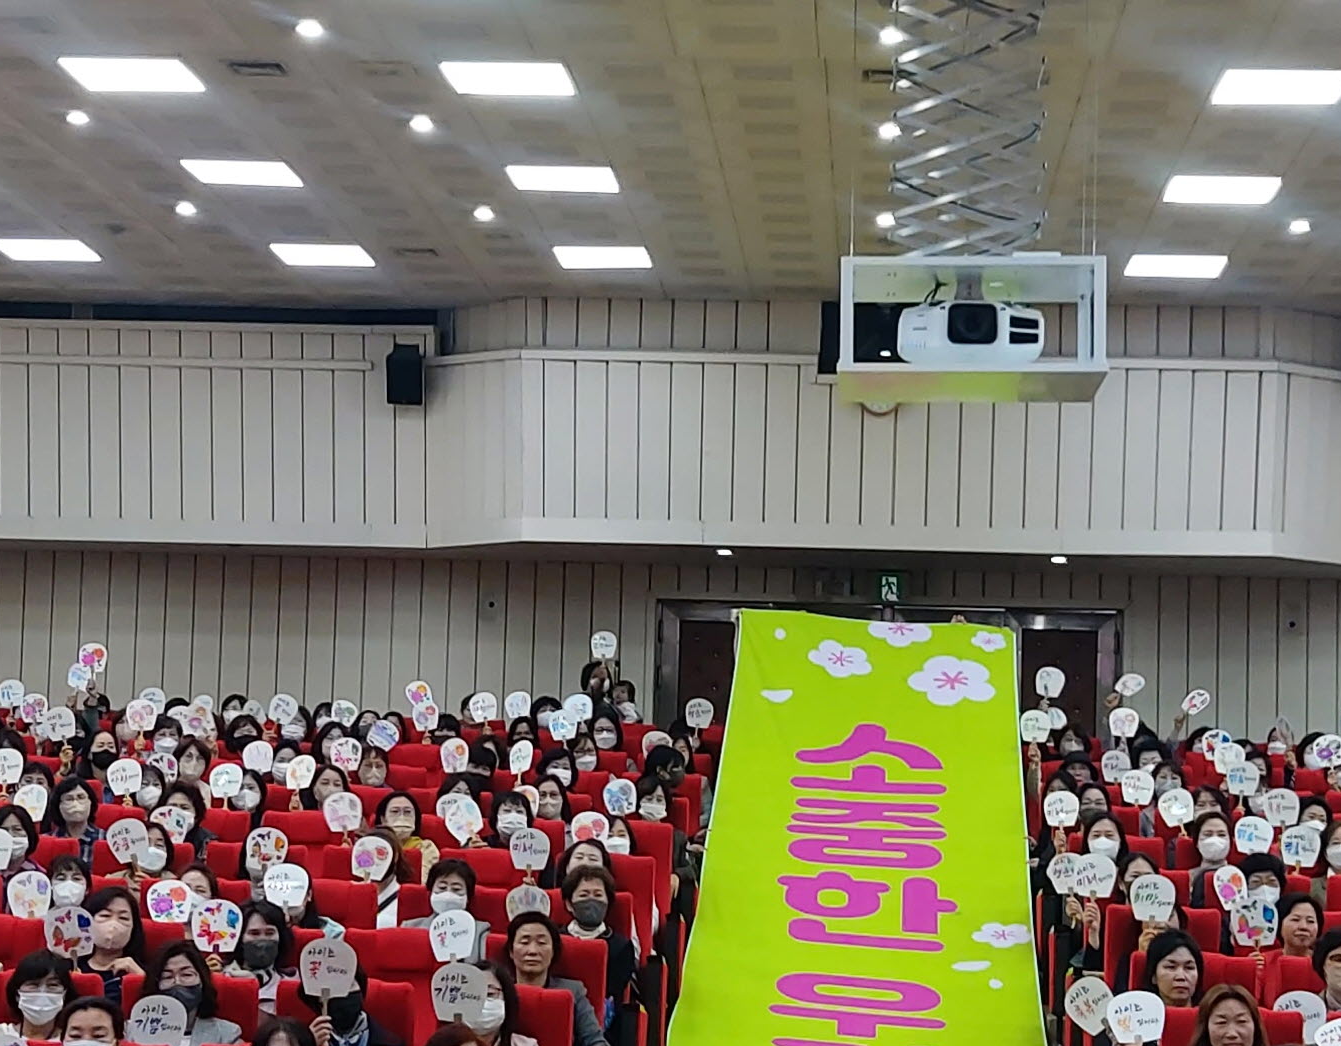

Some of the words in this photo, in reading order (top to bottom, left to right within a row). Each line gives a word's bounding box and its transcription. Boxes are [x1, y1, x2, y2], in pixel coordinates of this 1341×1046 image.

[778, 722, 959, 952] 소중한
[307, 947, 335, 958] 아이는
[440, 973, 468, 984] 아이는
[141, 1004, 169, 1016] 아이는
[1115, 1003, 1143, 1014] 아이는
